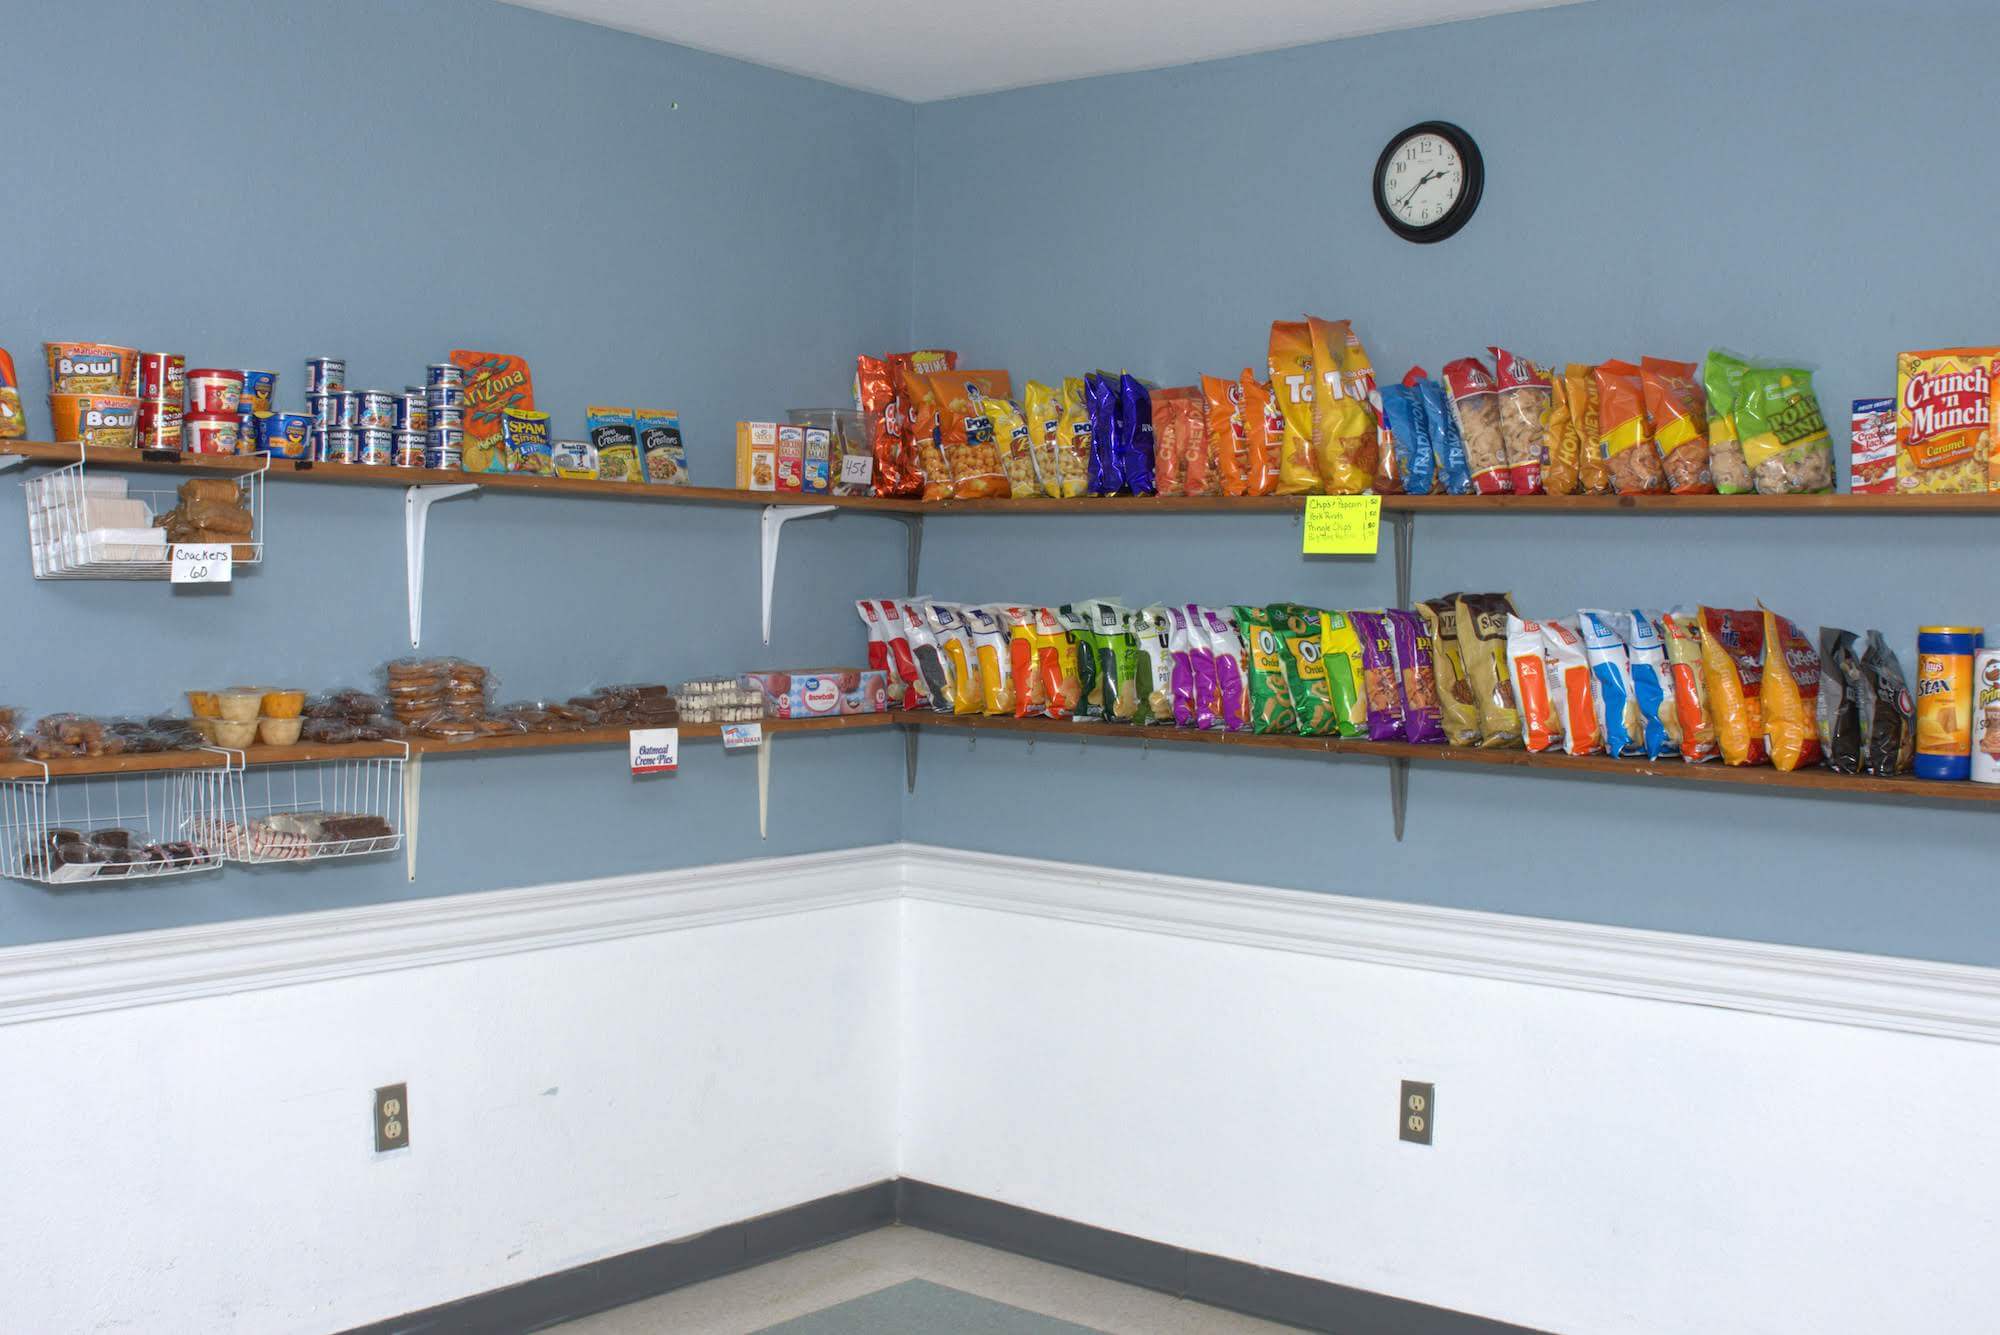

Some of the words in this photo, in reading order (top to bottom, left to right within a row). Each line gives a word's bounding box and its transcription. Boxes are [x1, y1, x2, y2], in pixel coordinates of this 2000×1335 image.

[1420, 141, 1432, 154] 12
[1438, 144, 1444, 156] 1
[1406, 148, 1416, 160] 11
[1447, 154, 1455, 166] 2
[1396, 162, 1407, 174] 10
[1453, 171, 1460, 183] 3
[1390, 179, 1397, 190] 9
[1446, 187, 1453, 199] 4
[1407, 206, 1413, 217] 7
[1421, 208, 1429, 219] 6
[1436, 203, 1443, 214] 5
[59, 358, 118, 374] Bowl
[1907, 369, 1989, 408] Crunch
[1913, 399, 1989, 440] Munch
[508, 421, 546, 434] SPAM
[1584, 407, 1601, 460] HONEY
[597, 434, 632, 448] Creations
[647, 435, 678, 448] Creations
[1926, 436, 1966, 457] Caramel
[845, 460, 867, 477] 45¢
[175, 549, 229, 561] Crackers
[781, 696, 788, 706] 12
[639, 743, 669, 755] Oatmeal
[634, 755, 657, 766] Creme
[657, 754, 673, 765] Pies
